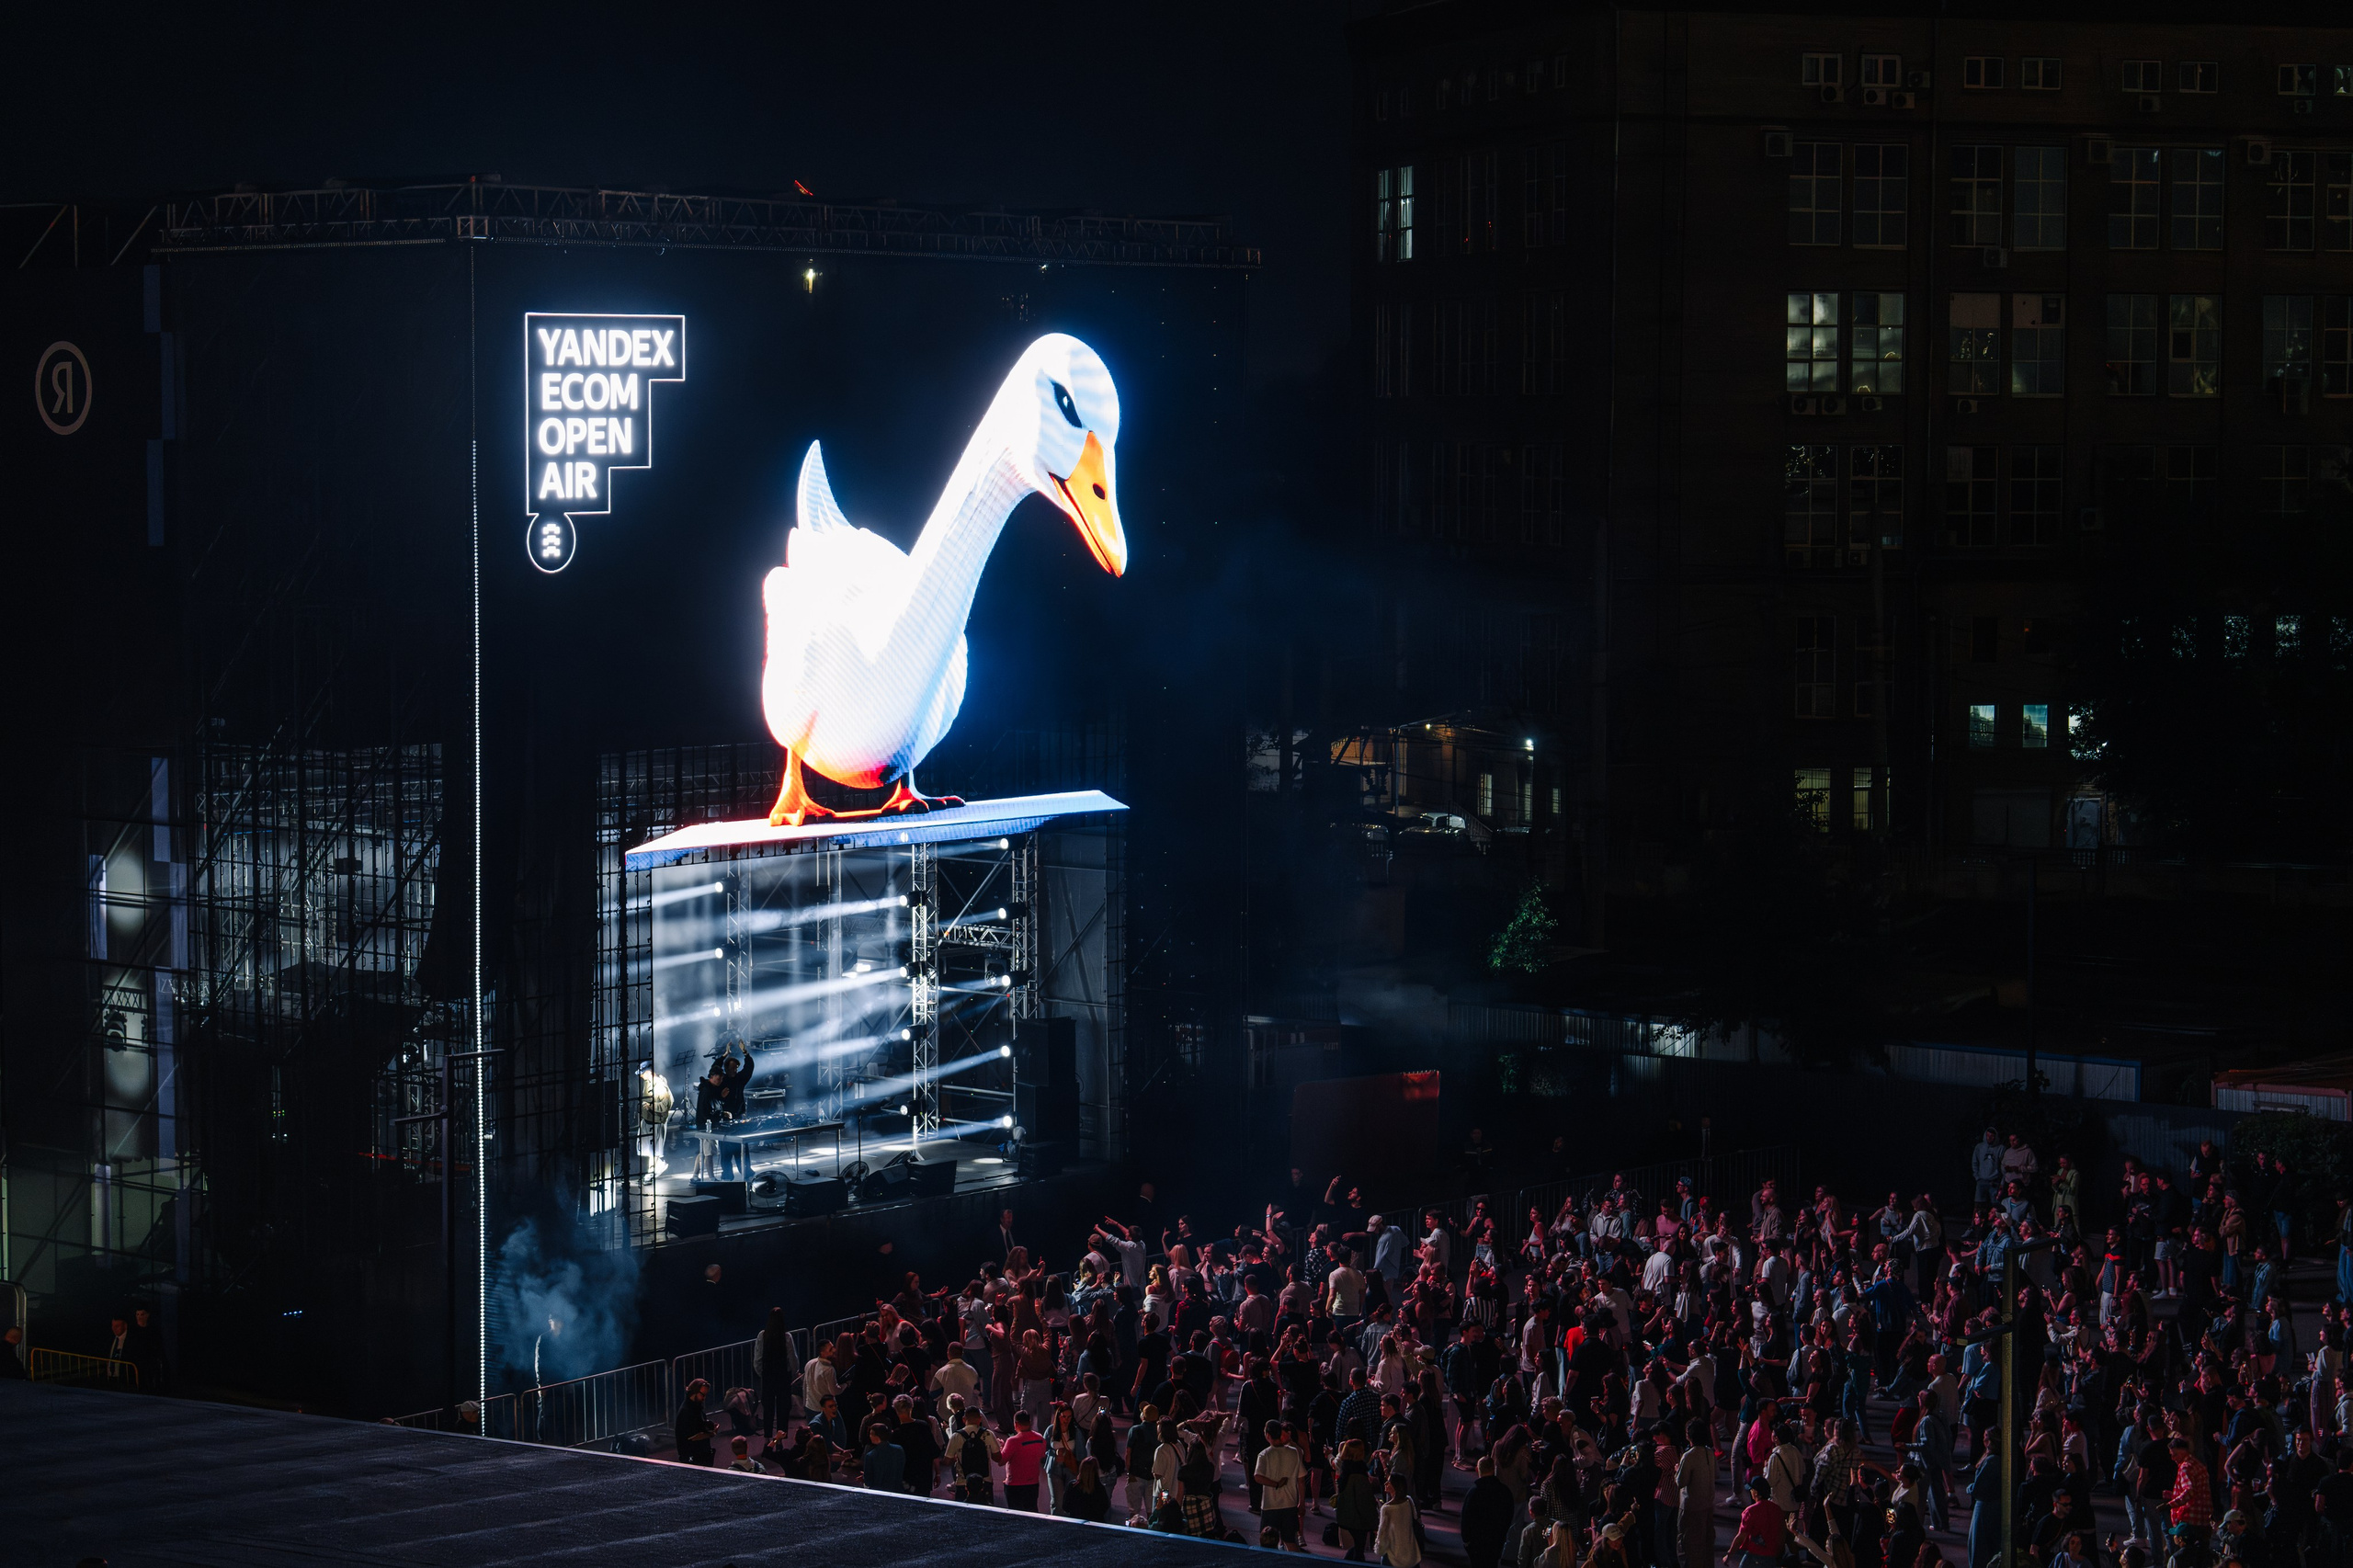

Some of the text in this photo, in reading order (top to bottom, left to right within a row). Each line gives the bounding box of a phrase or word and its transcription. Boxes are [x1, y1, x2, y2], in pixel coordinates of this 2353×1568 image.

[538, 328, 675, 366] YANDEX
[51, 361, 74, 414] Я
[541, 372, 639, 410] ECOM
[539, 417, 632, 455] OPEN
[539, 461, 597, 499] AIR
